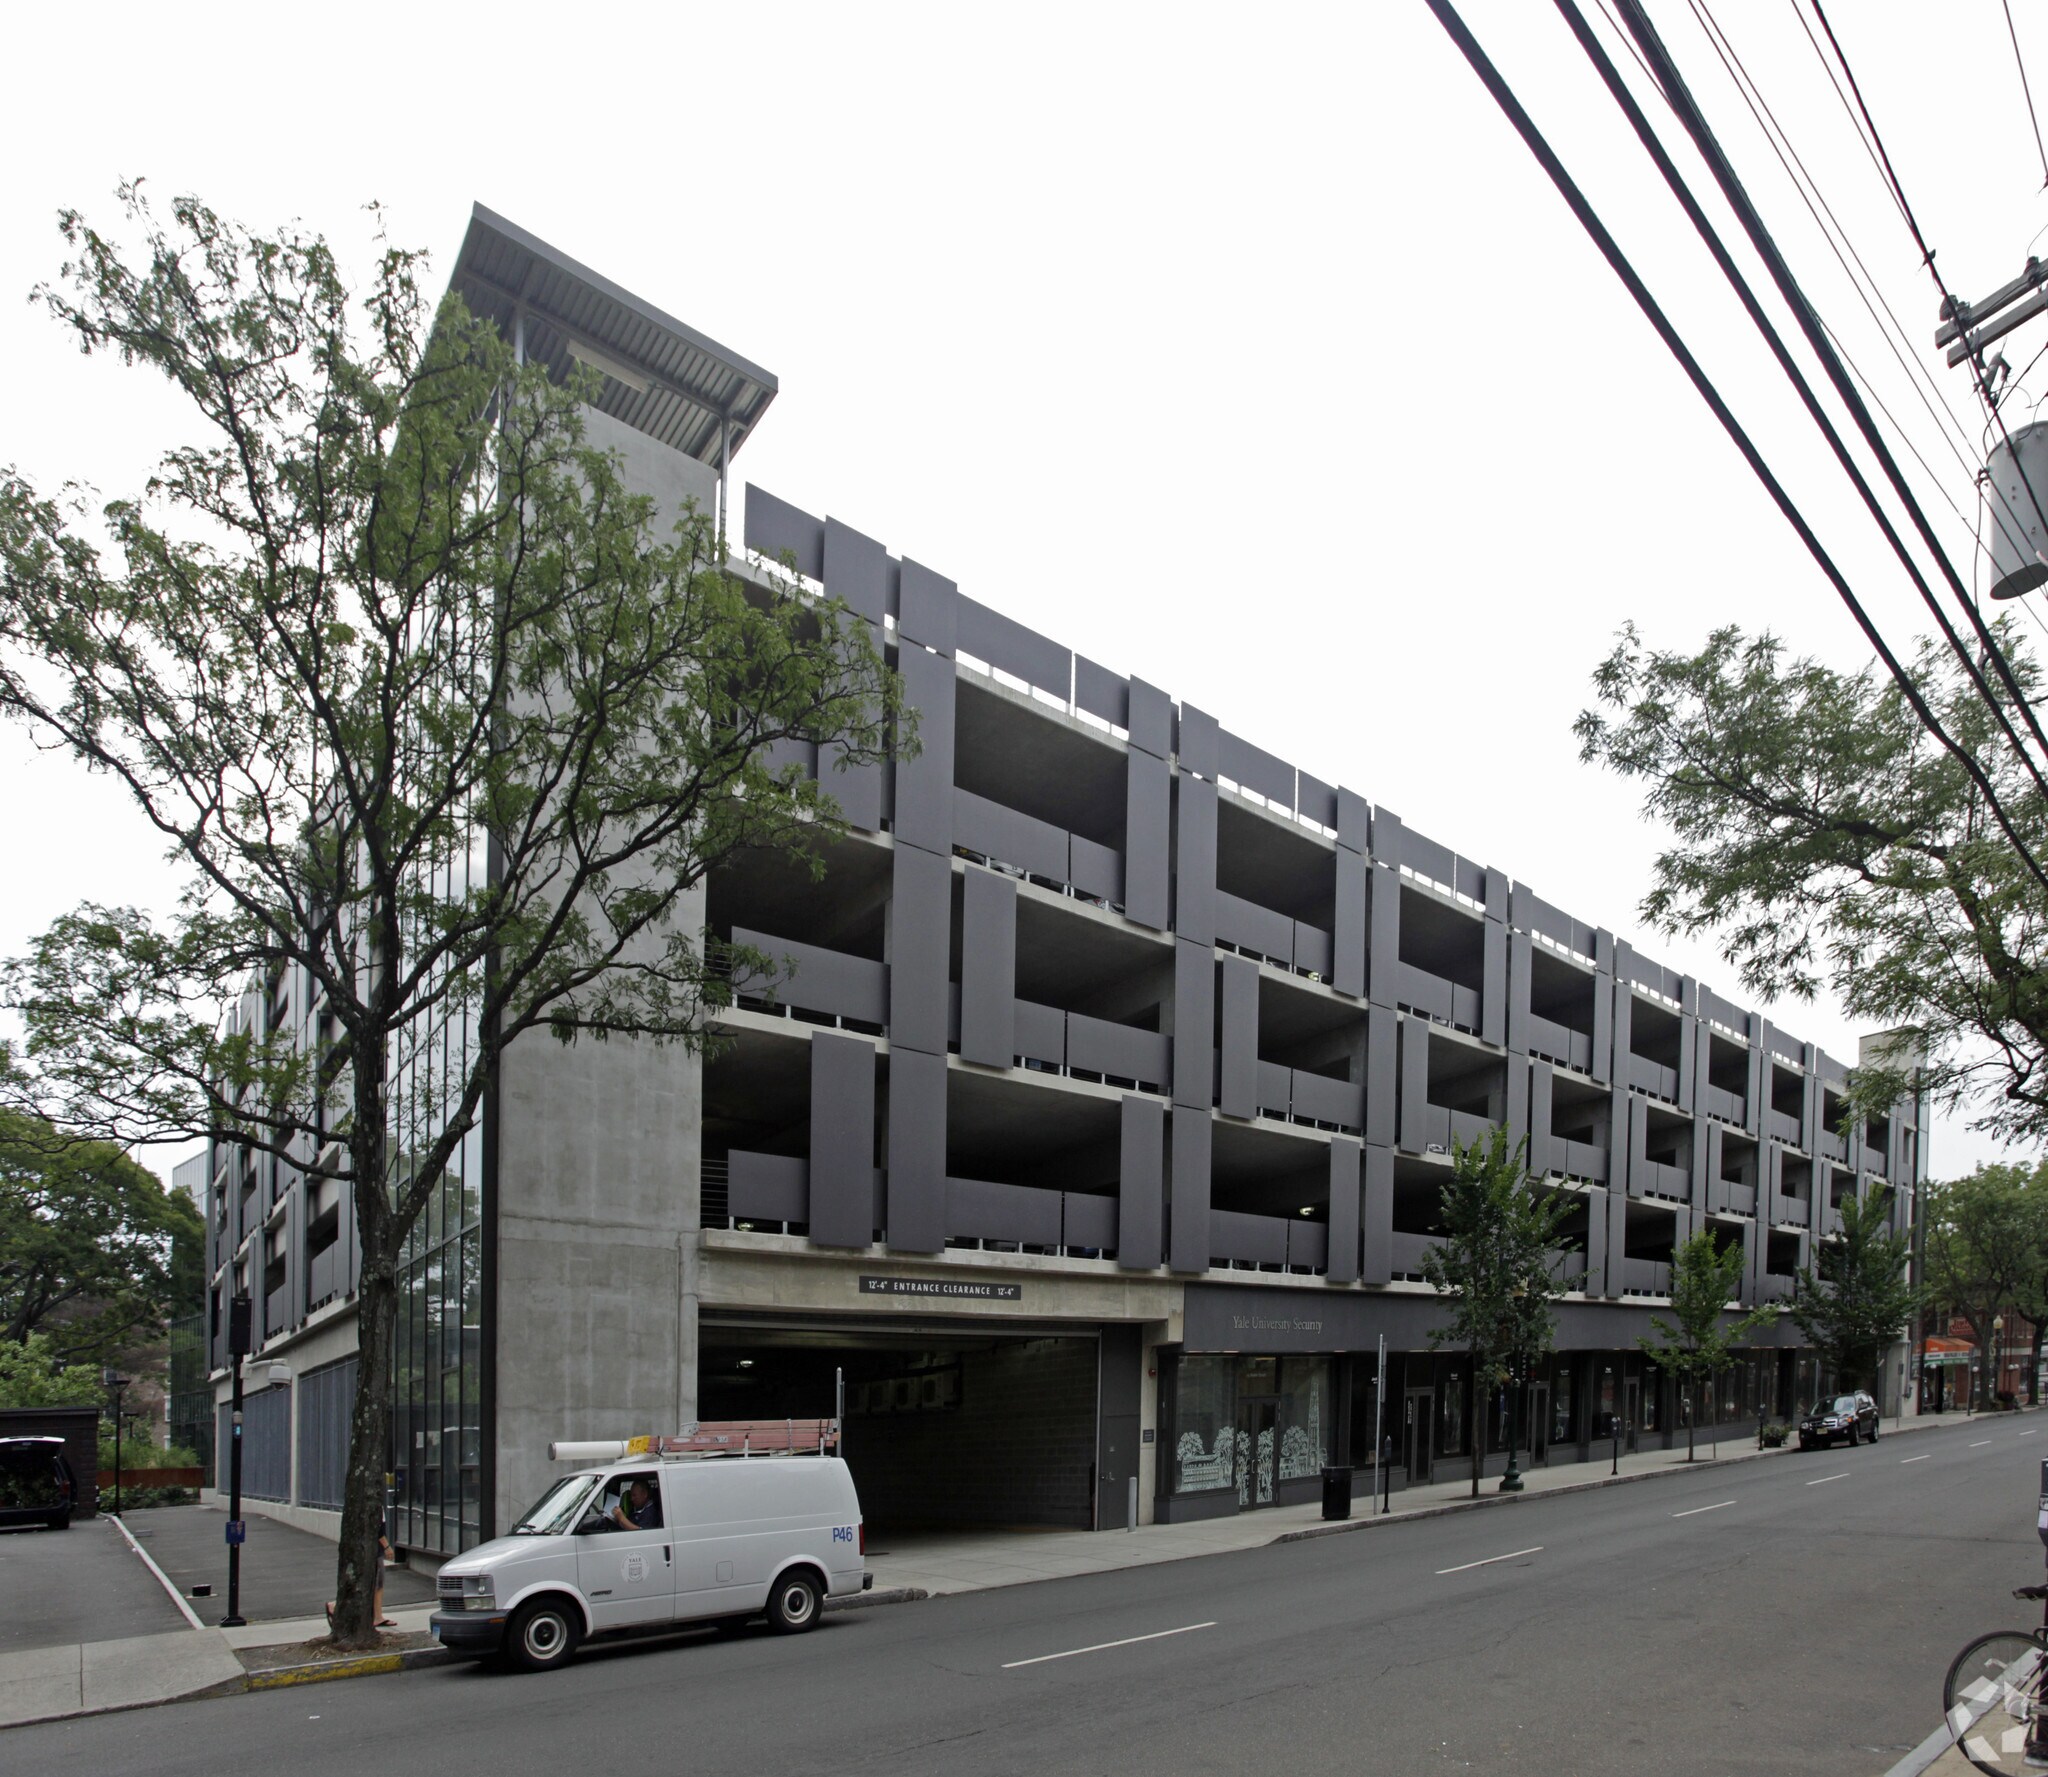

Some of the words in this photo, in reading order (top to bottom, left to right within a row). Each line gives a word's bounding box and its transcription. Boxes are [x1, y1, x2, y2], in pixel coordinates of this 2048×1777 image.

[894, 1282, 939, 1293] ENTRANCE
[943, 1284, 991, 1296] CLEARANCE
[1233, 1316, 1250, 1329] Yale
[1252, 1316, 1291, 1334] University
[1293, 1317, 1323, 1335] Security
[832, 1526, 853, 1543] P46
